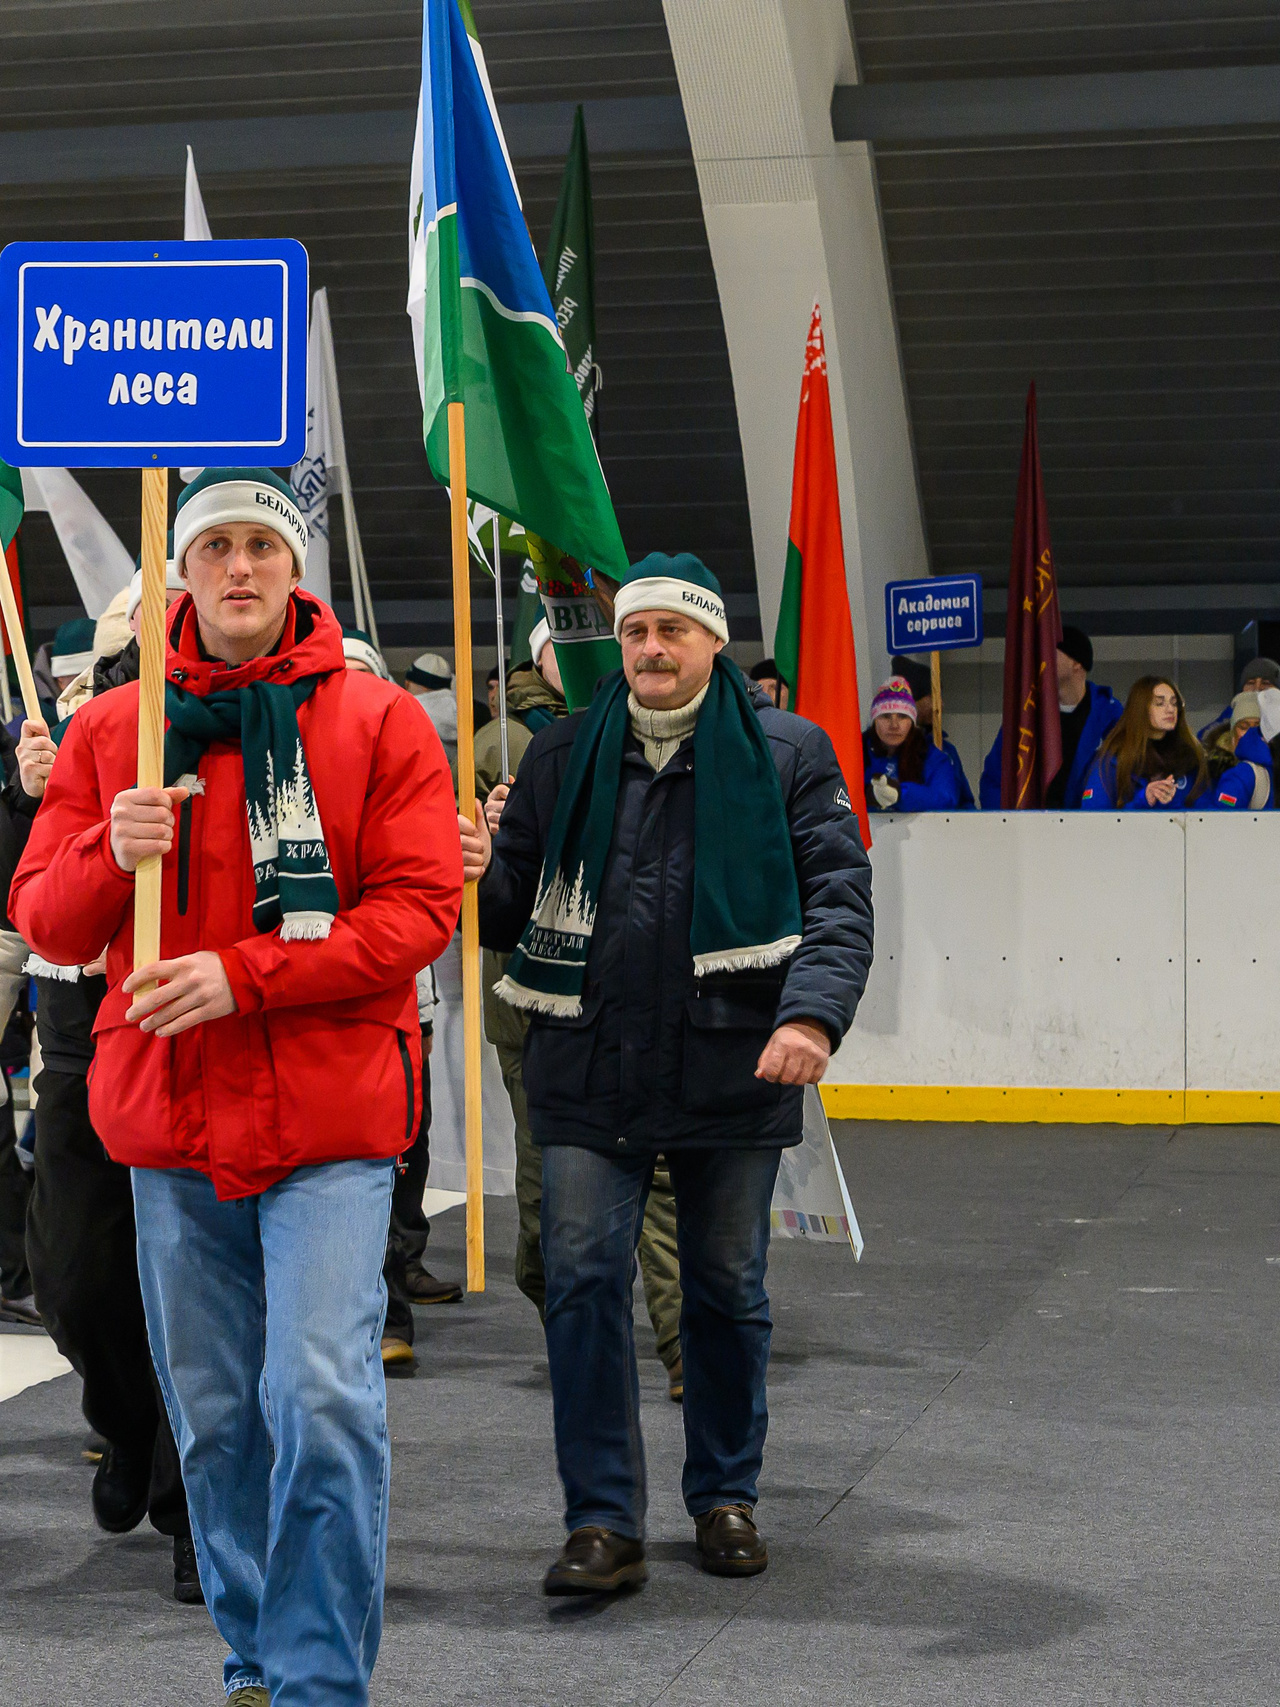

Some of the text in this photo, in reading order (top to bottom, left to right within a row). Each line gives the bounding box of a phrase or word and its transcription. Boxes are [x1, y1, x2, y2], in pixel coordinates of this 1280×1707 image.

[33, 303, 273, 365] Хранители
[108, 372, 198, 406] леса
[898, 593, 970, 615] Академия
[907, 616, 962, 636] сервиса
[286, 842, 329, 859] ХРА
